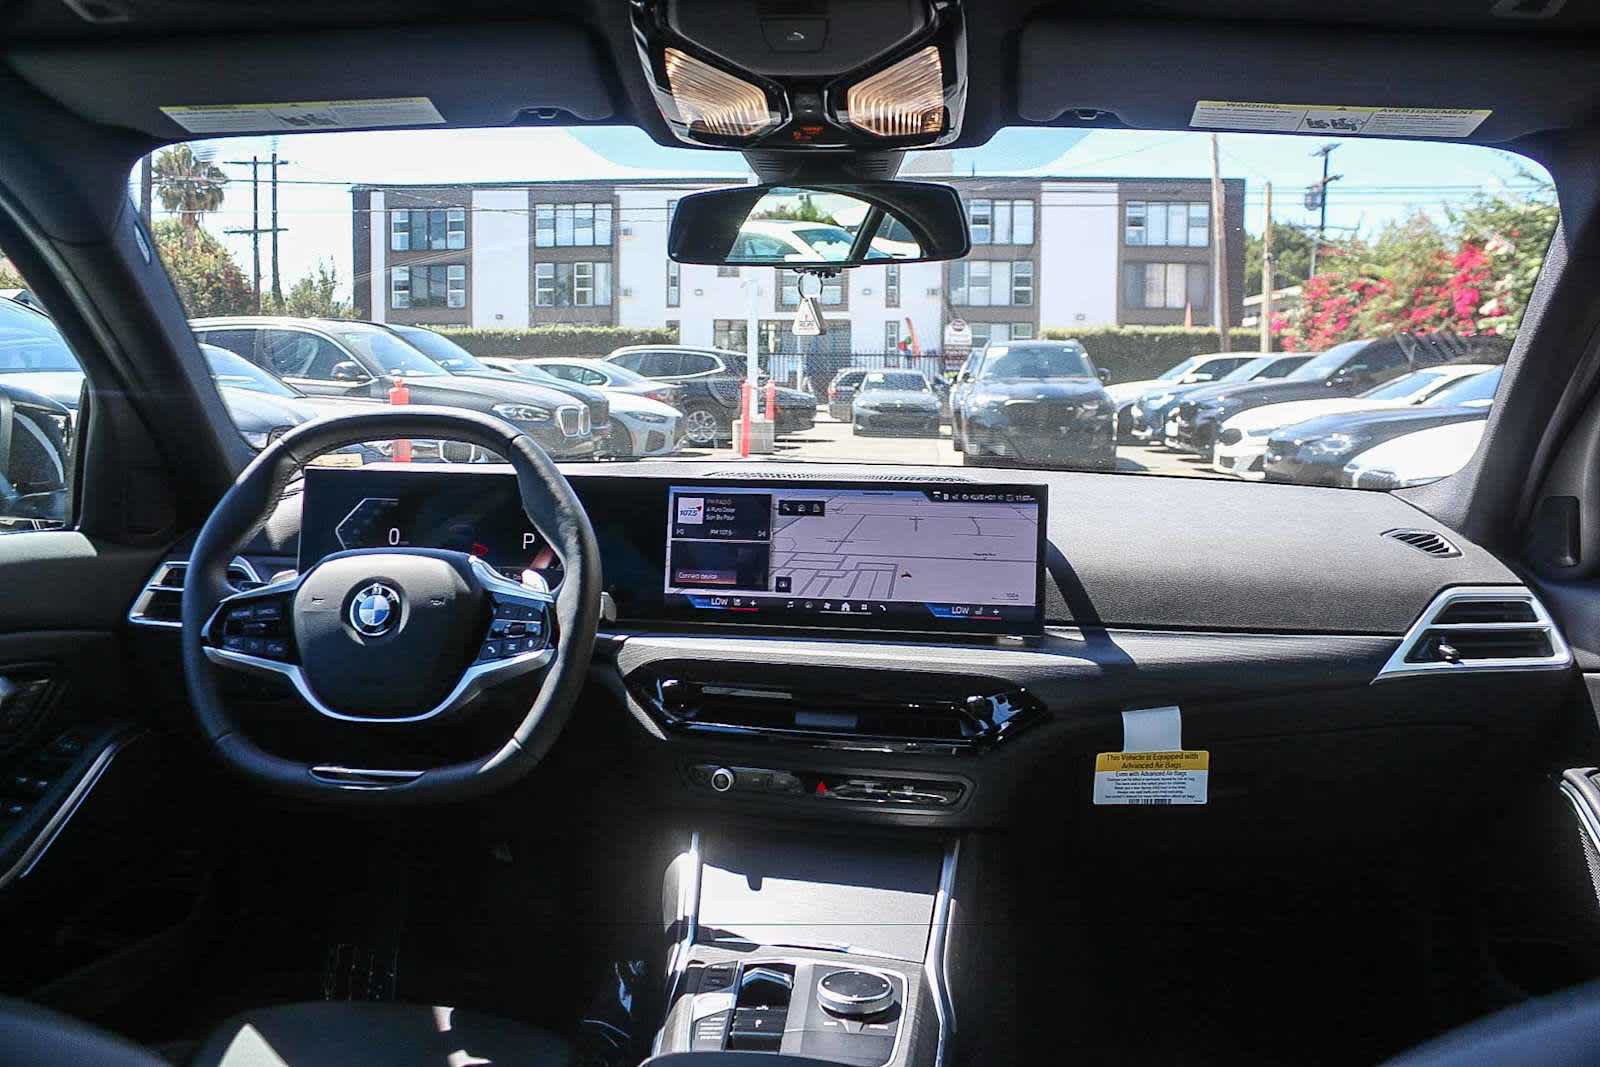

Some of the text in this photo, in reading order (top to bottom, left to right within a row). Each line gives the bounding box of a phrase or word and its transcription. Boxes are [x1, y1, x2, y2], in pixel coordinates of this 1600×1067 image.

[389, 527, 400, 545] 0
[522, 532, 535, 550] P
[711, 597, 728, 606] LOW
[951, 606, 970, 615] LOW
